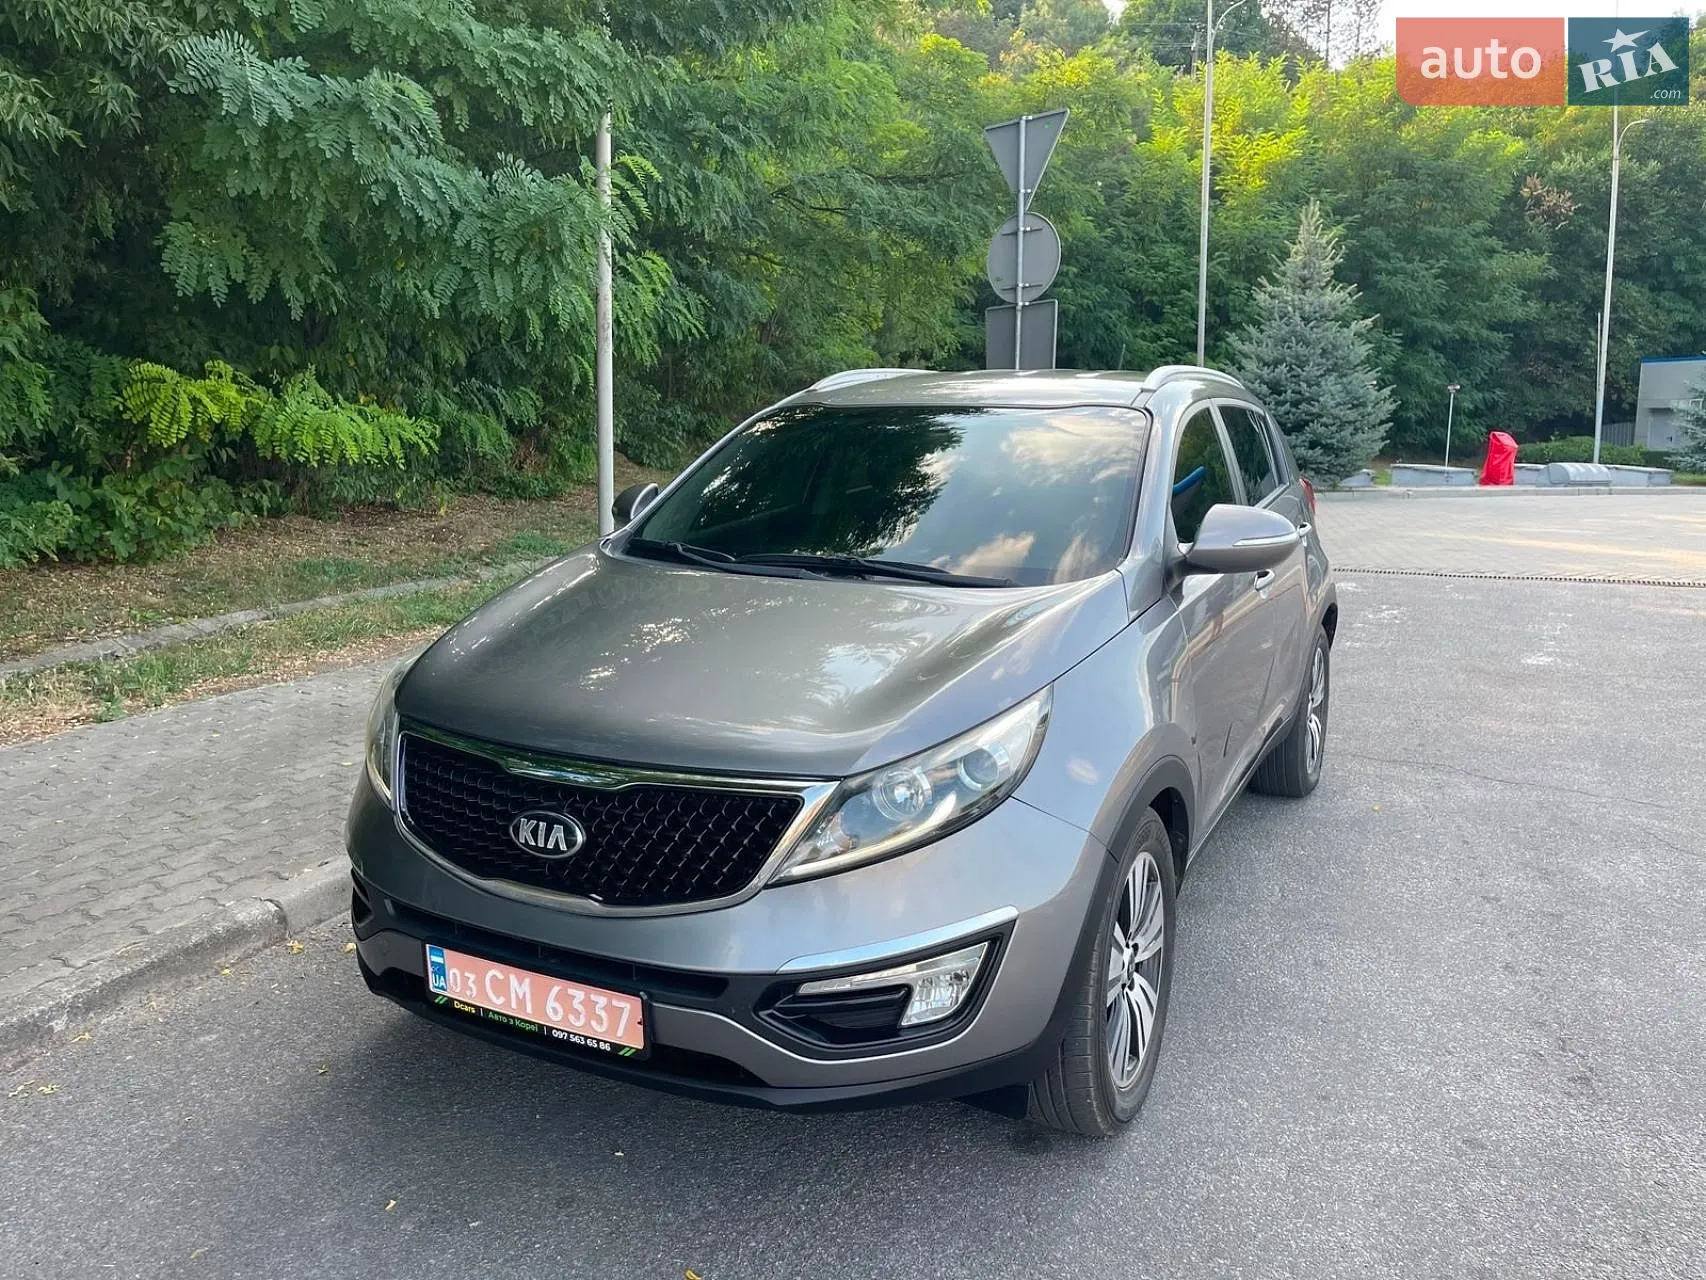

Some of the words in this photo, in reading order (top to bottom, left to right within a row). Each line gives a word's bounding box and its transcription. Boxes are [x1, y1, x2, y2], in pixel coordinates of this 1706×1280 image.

[519, 818, 568, 851] KIA
[432, 973, 447, 990] UA
[449, 968, 478, 999] 03
[485, 969, 533, 1015] CM
[546, 985, 631, 1037] 6337
[454, 1001, 476, 1014] Dcars
[551, 1029, 568, 1040] 097
[569, 1034, 586, 1045] 563
[586, 1038, 599, 1049] 65
[599, 1042, 612, 1052] 86
